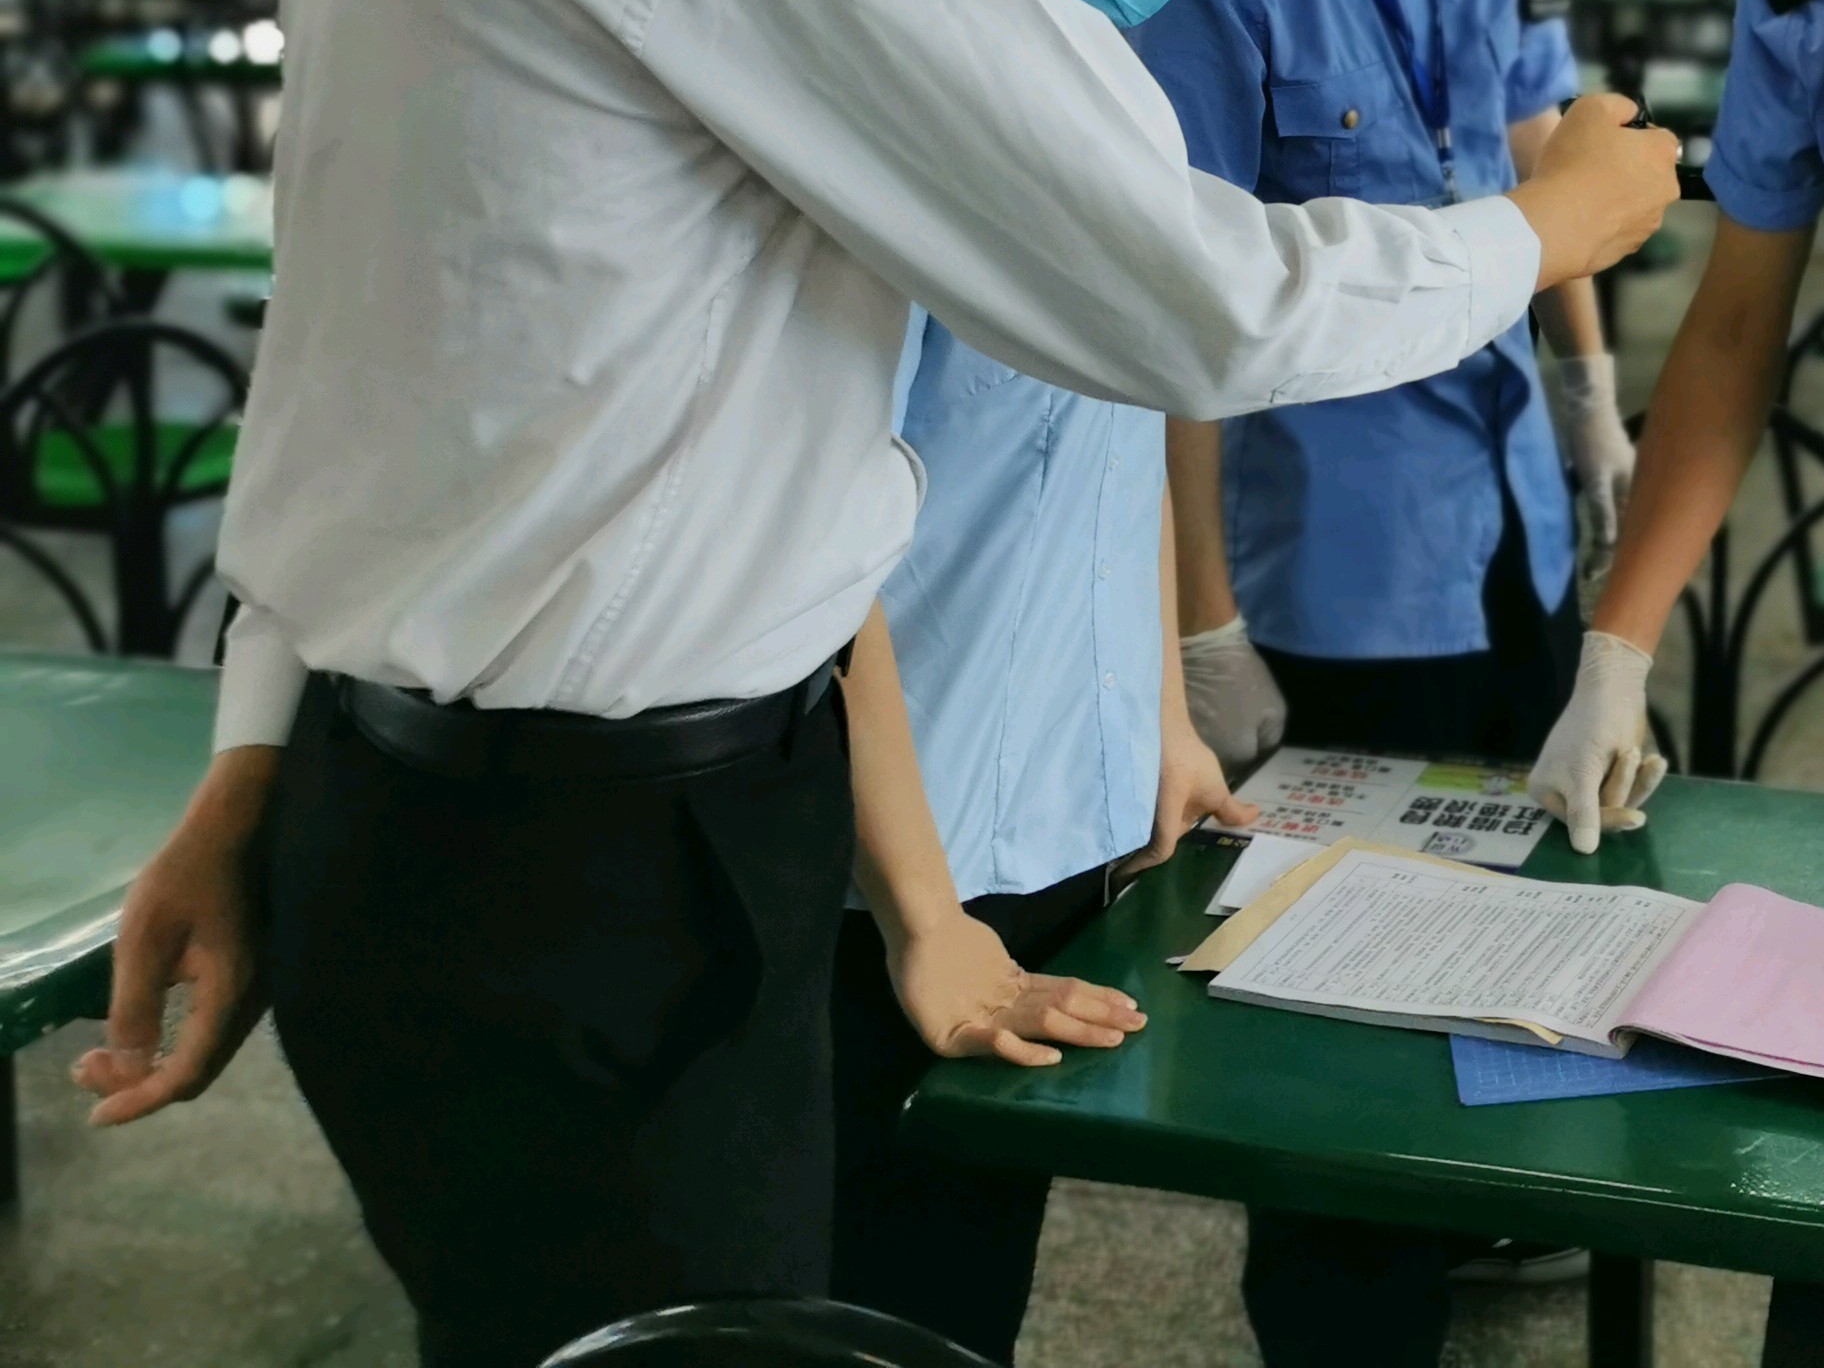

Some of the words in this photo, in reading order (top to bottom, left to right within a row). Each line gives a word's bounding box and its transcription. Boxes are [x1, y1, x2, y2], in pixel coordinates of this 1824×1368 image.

[1410, 797, 1547, 820] 杜绝浪费
[1399, 810, 1537, 835] 珍惜粮食
